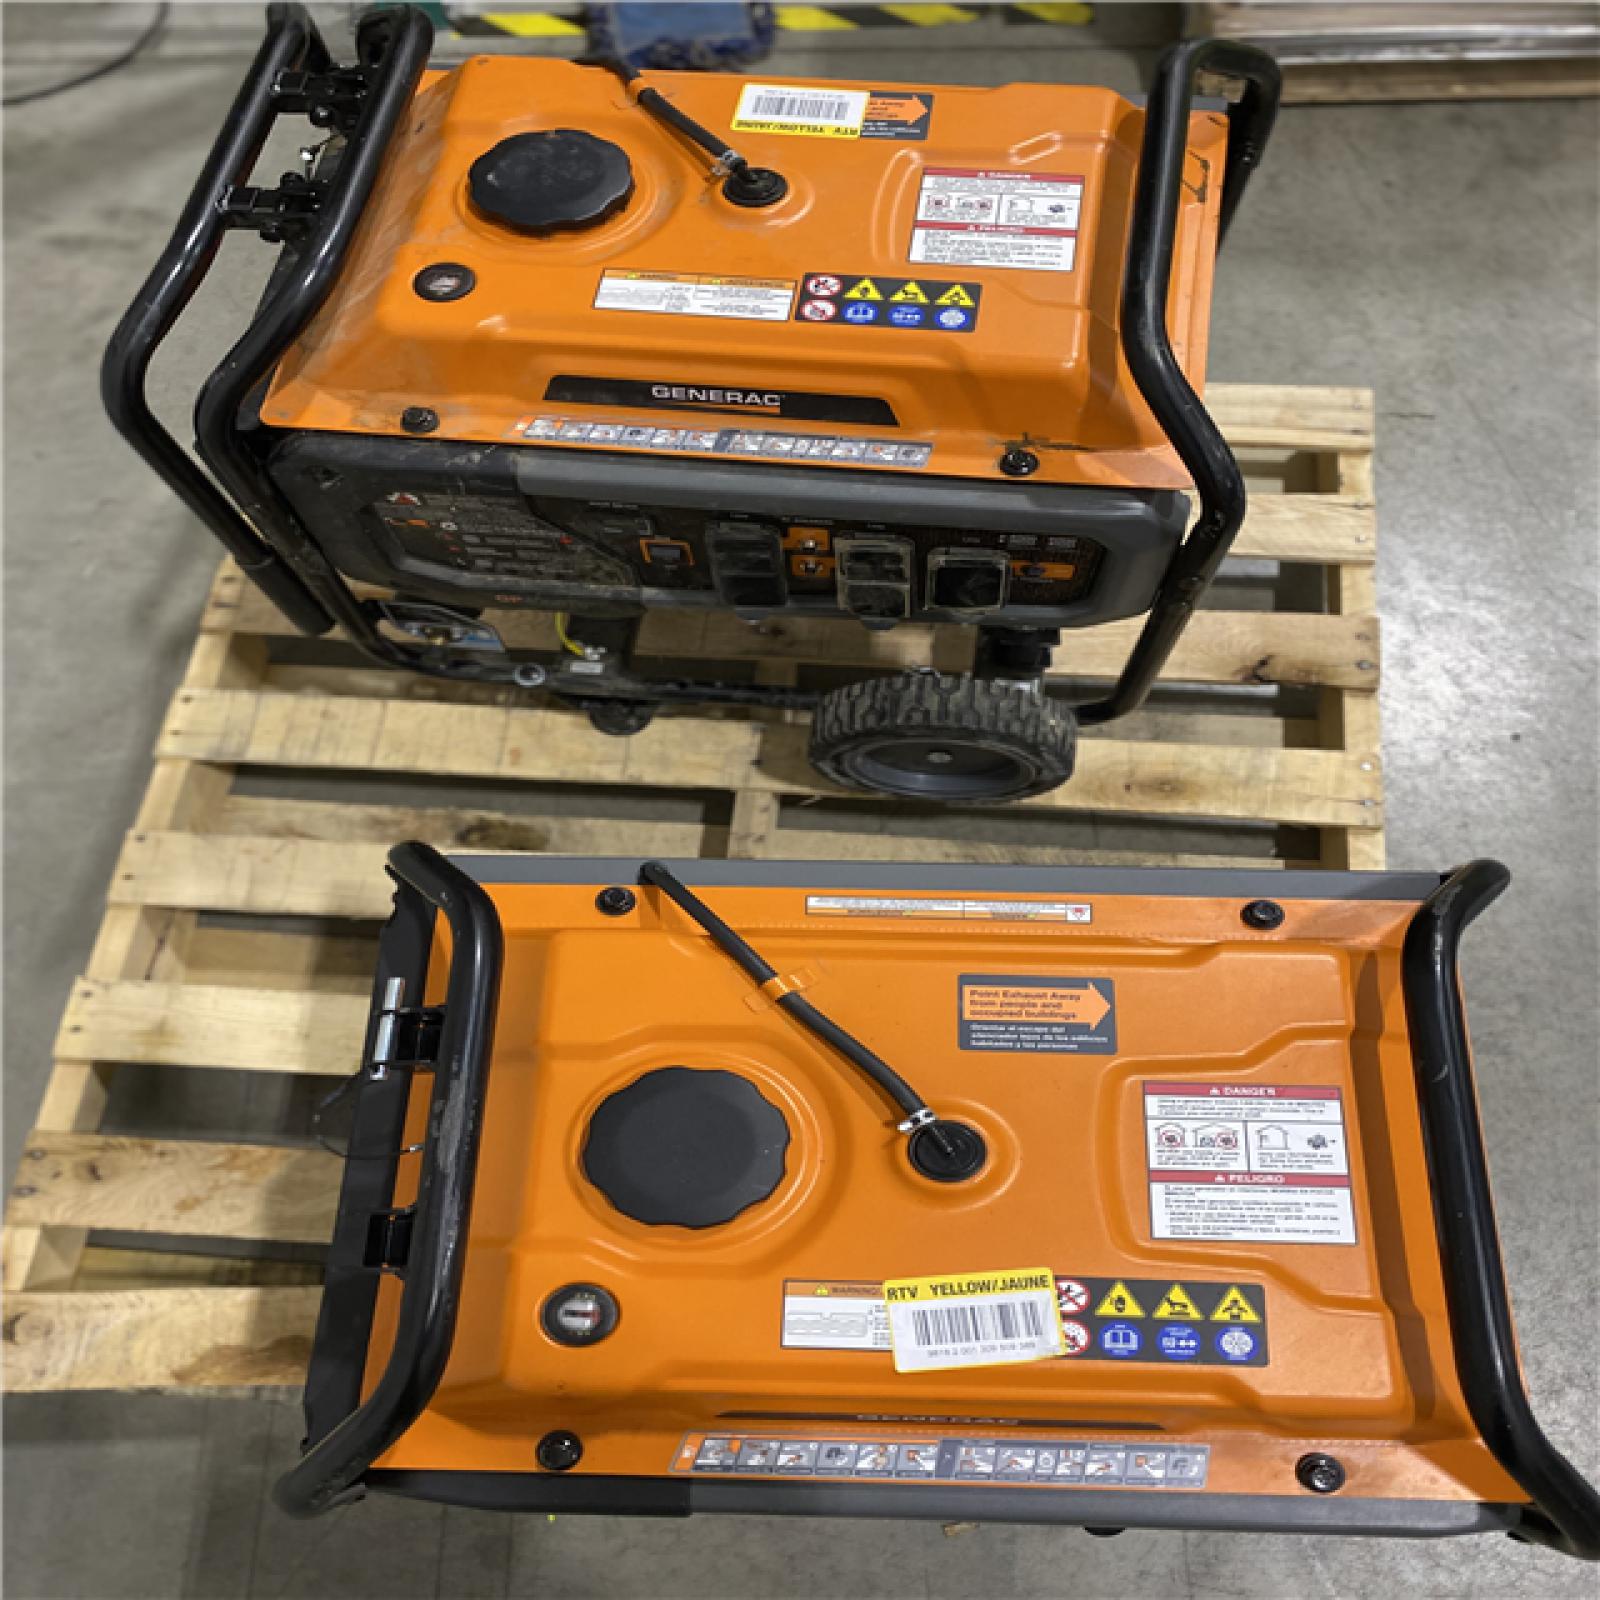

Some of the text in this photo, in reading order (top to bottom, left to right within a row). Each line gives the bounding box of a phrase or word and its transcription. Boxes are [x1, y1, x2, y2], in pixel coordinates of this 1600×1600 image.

[651, 384, 781, 406] GENERAC
[1223, 1086, 1277, 1097] DANGER
[887, 1274, 1051, 1301] RTV YELLOW/JAUNE
